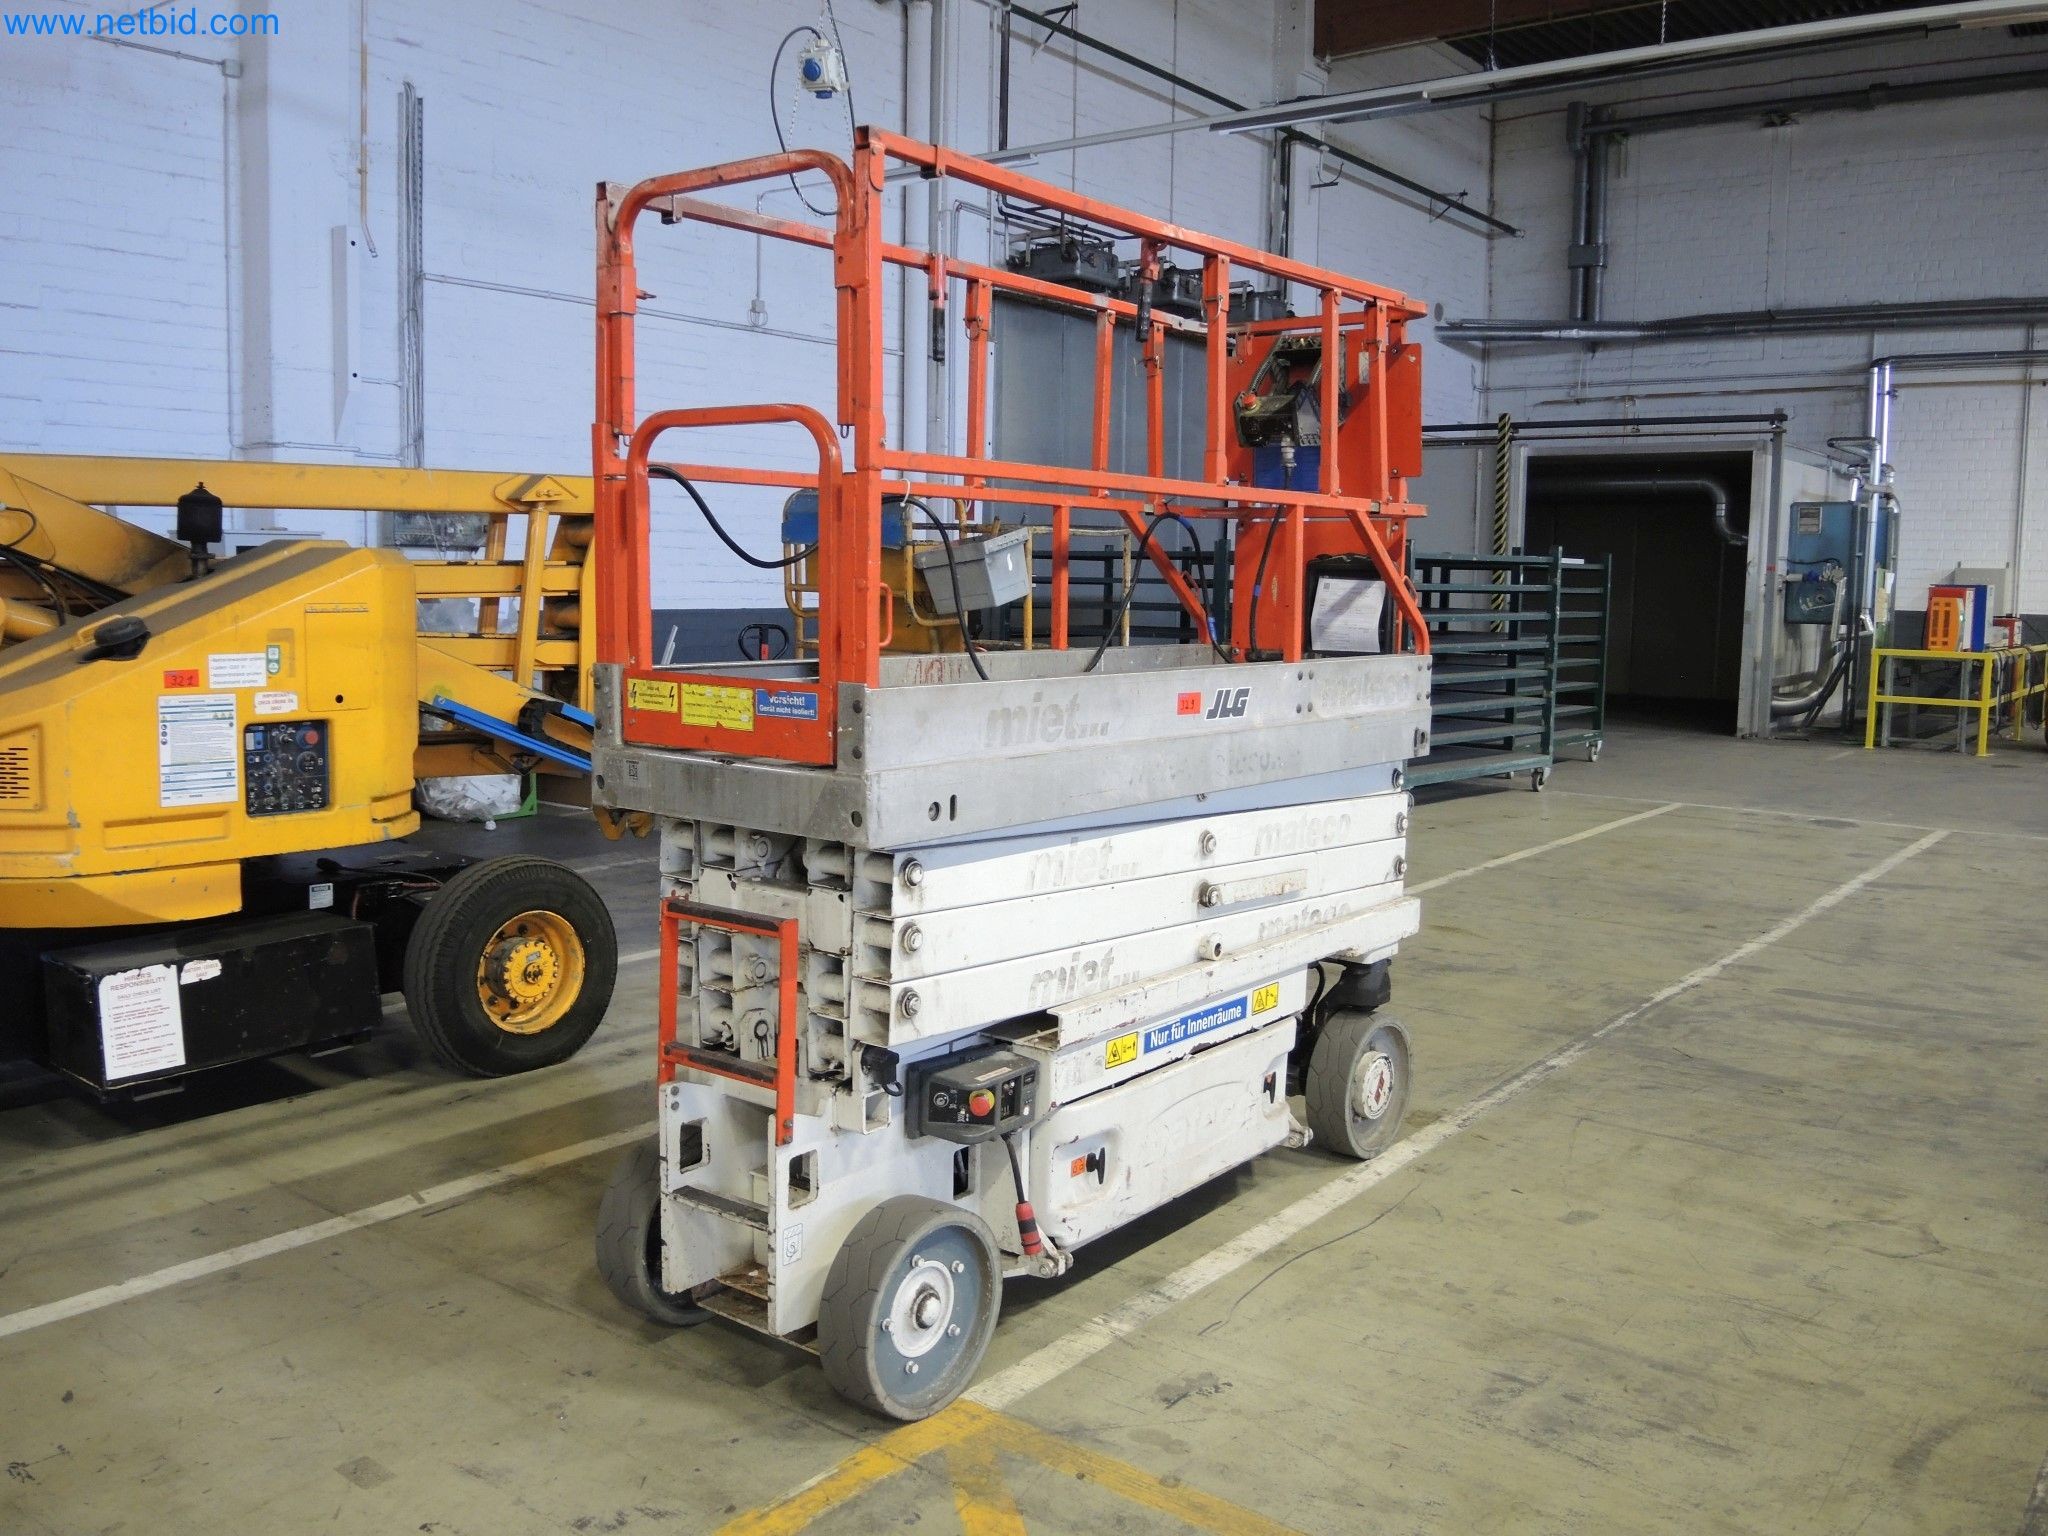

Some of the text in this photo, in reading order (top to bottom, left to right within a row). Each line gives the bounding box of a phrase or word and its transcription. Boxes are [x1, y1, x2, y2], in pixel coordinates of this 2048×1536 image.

[776, 706, 791, 714] nicht
[1205, 688, 1251, 720] JLG
[1150, 1005, 1242, 1049] Nur für Innenräume
